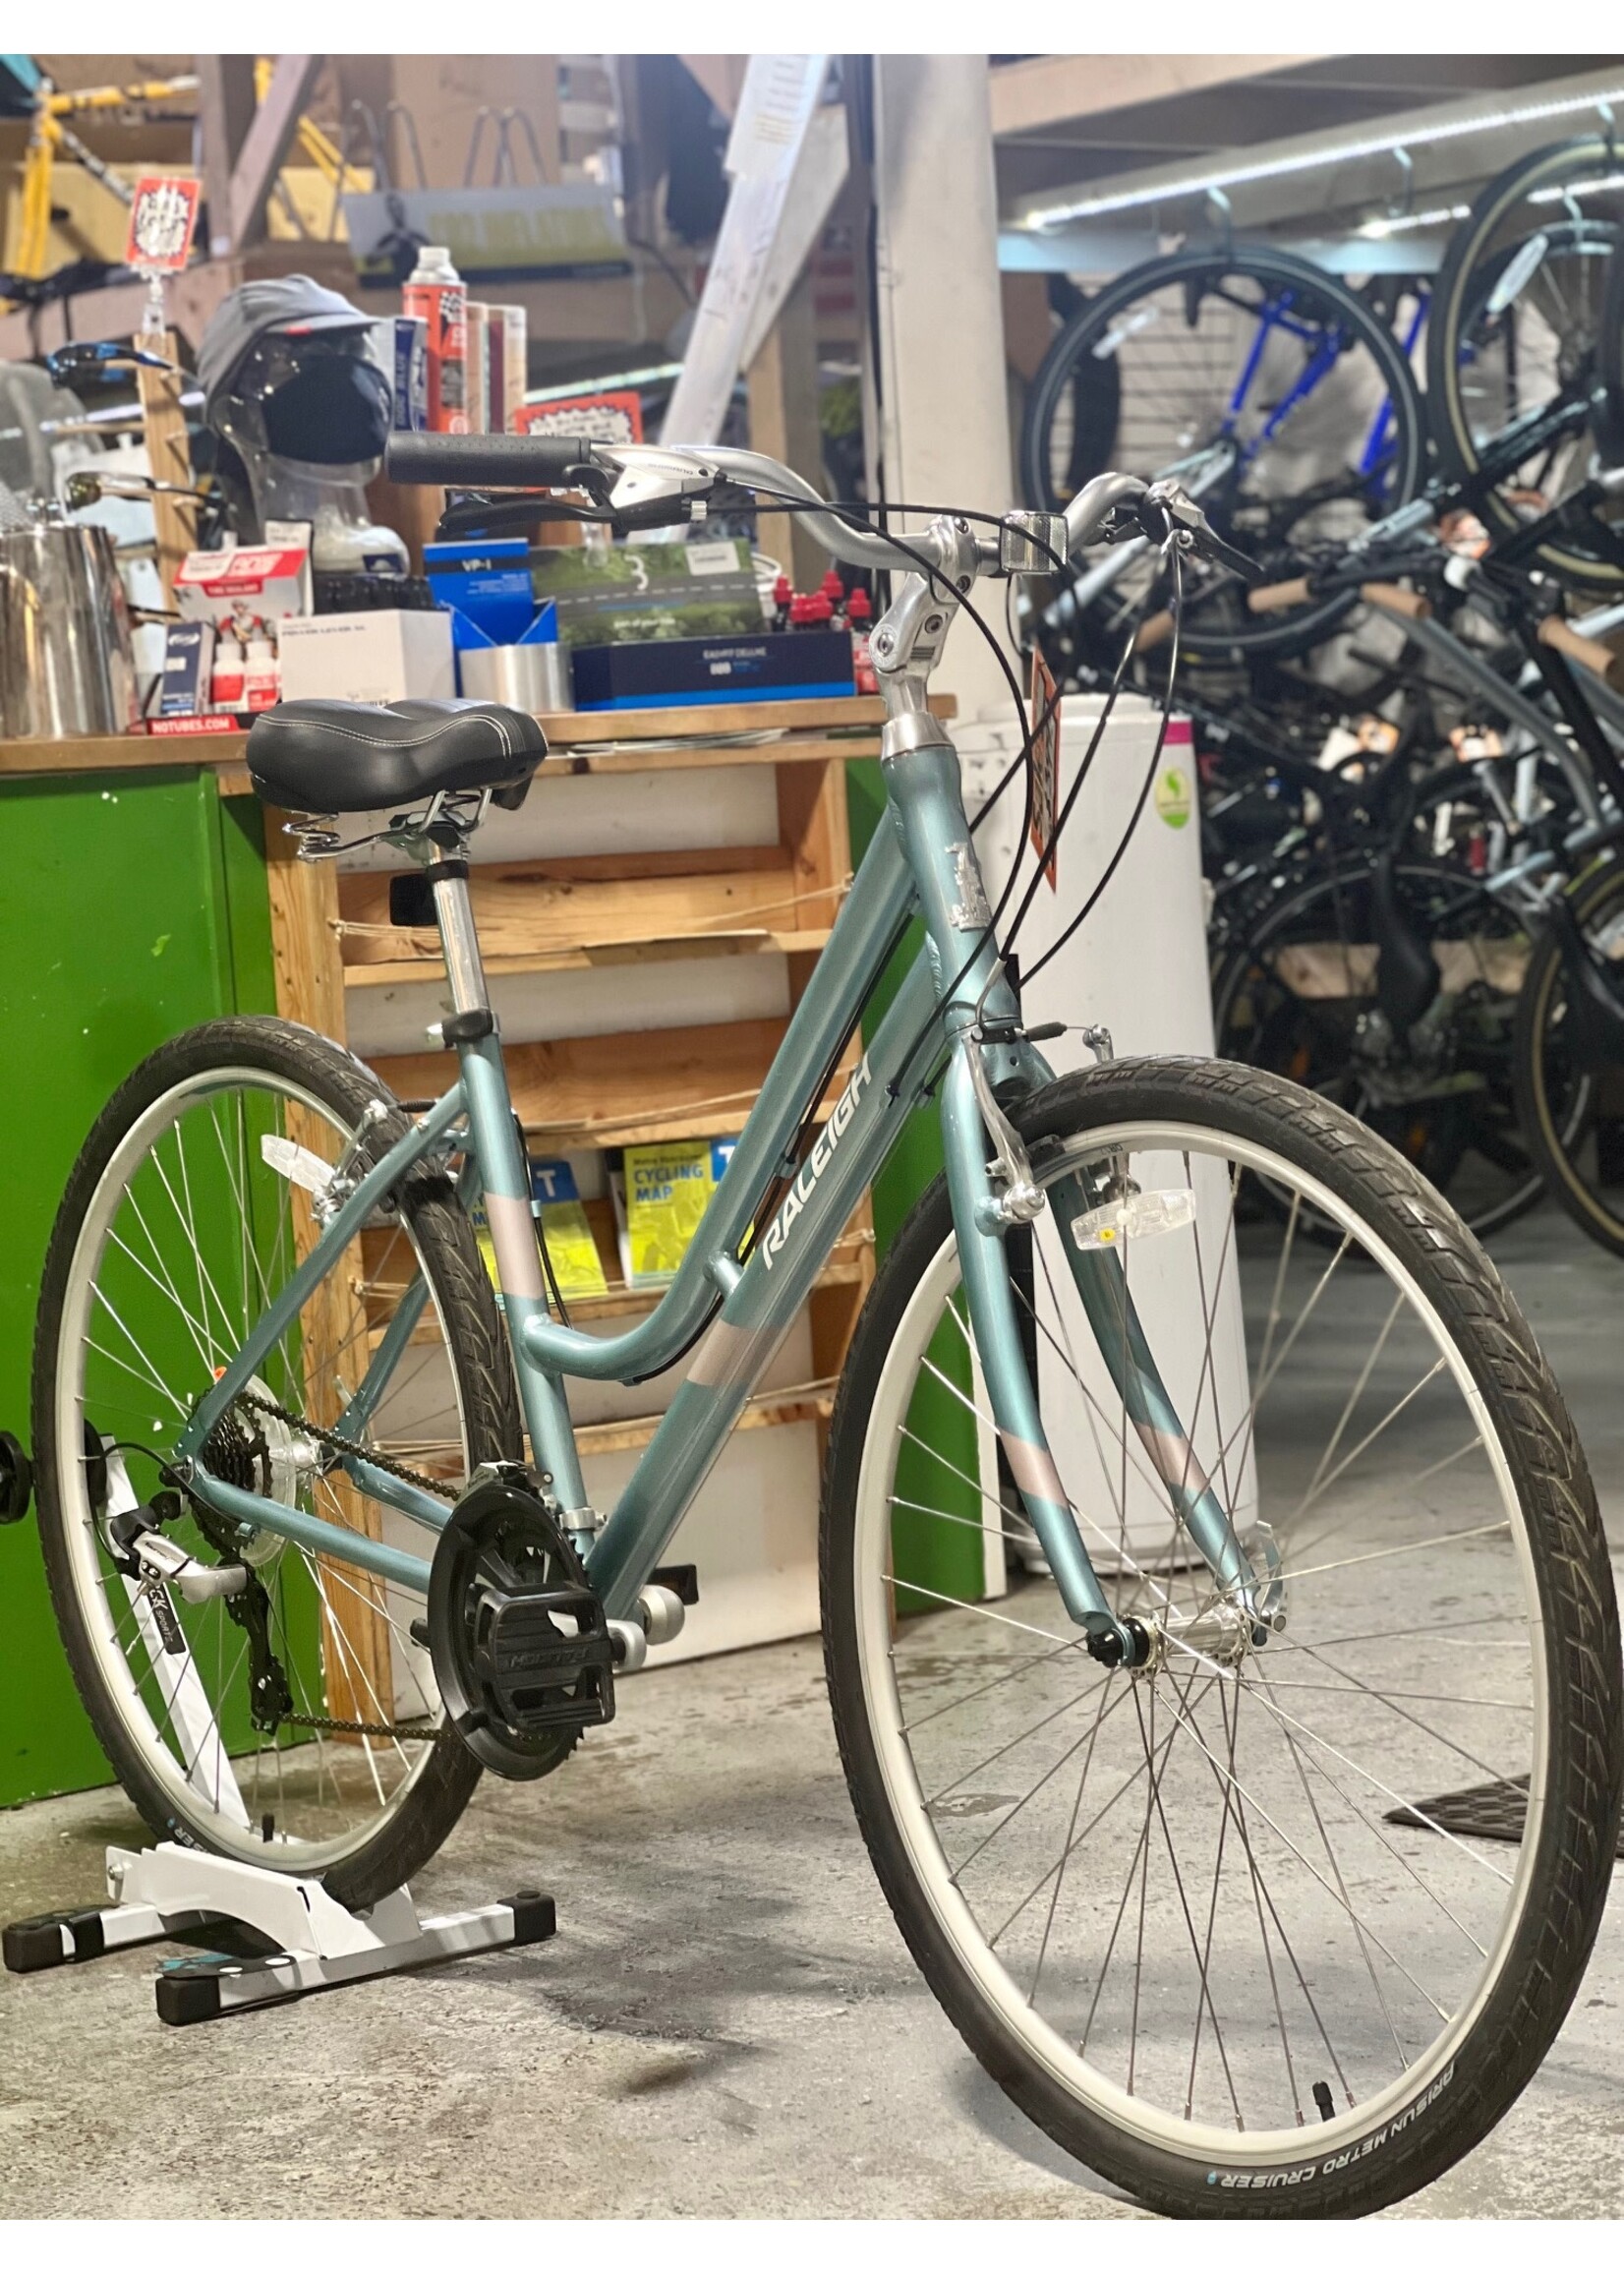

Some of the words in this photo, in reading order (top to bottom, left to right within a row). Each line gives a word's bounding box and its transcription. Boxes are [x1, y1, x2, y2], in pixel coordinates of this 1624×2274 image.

[152, 718, 231, 733] NOTUBES.COM
[634, 1164, 704, 1184] CYCLING
[762, 1051, 872, 1271] RALEIGH
[536, 1168, 556, 1198] T
[636, 1185, 672, 1202] MAP
[1390, 2061, 1456, 2137] ARISUN
[1322, 2129, 1388, 2175] METRO
[1220, 2166, 1317, 2188] CRUISER
